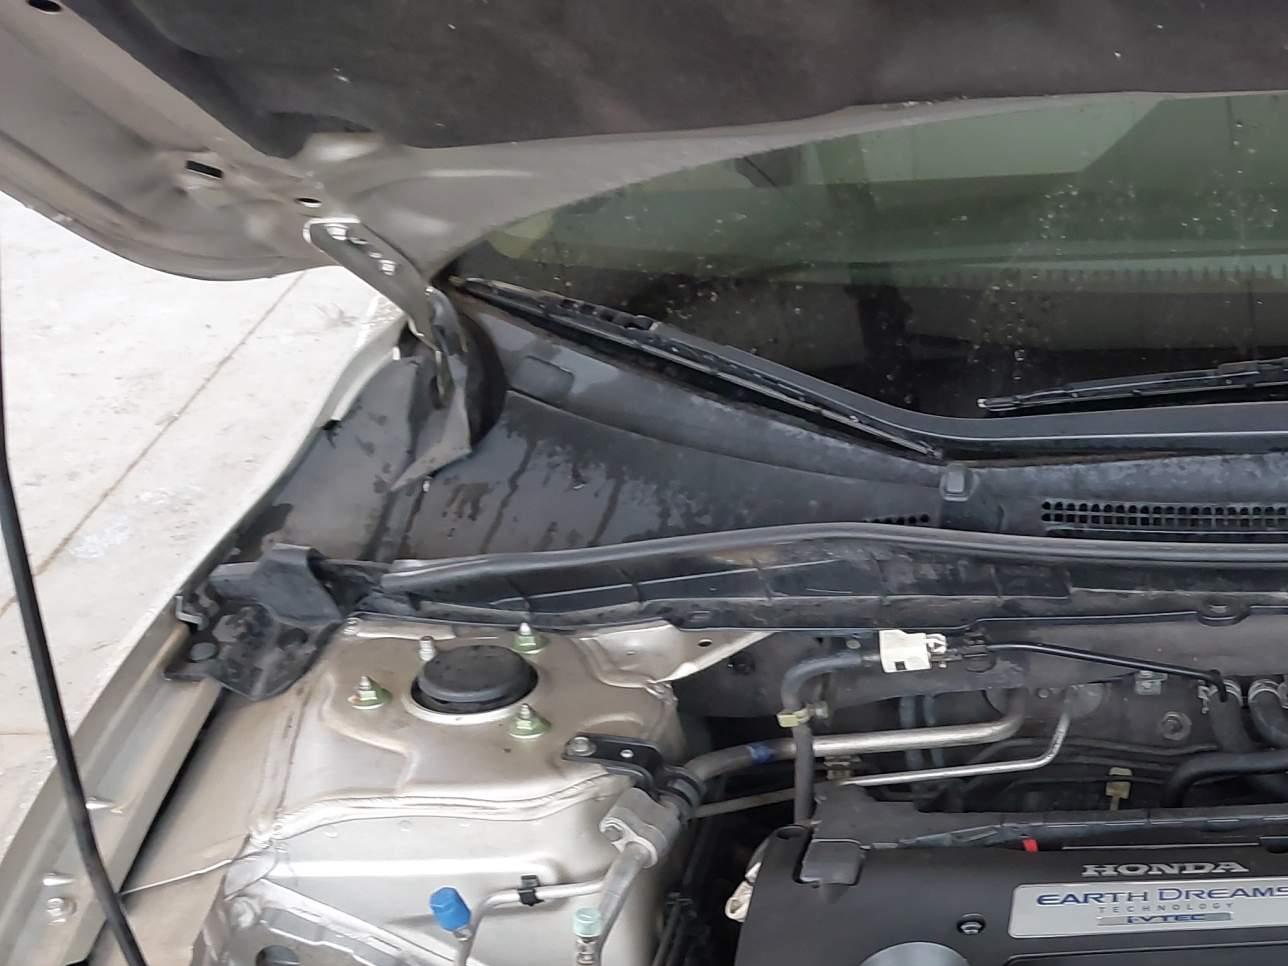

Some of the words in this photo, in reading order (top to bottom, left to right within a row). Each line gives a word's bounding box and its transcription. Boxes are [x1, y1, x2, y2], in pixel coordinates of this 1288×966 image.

[1081, 862, 1249, 877] HONDA
[1036, 892, 1148, 906] EARTH
[1098, 903, 1234, 914] TECHNOLOGY
